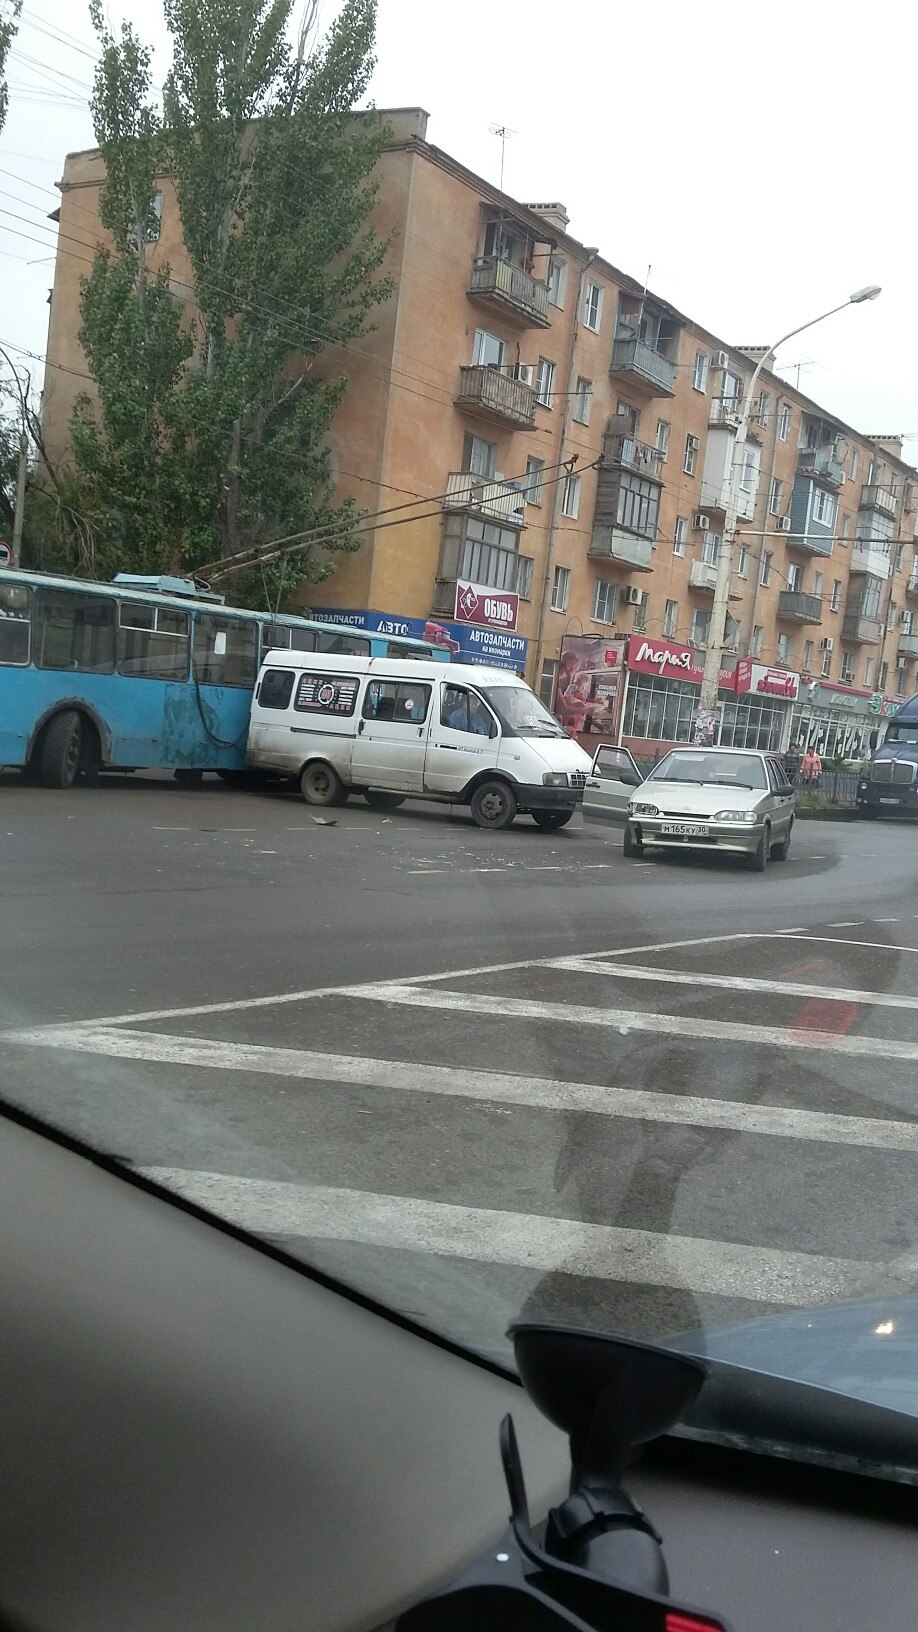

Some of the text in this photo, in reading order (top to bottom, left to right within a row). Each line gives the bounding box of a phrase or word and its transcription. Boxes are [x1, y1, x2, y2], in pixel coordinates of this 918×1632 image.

[484, 598, 514, 622] ОБУВЬ
[469, 630, 525, 651] АВТОЗАПЧАСТИ
[664, 825, 696, 834] М165КУ
